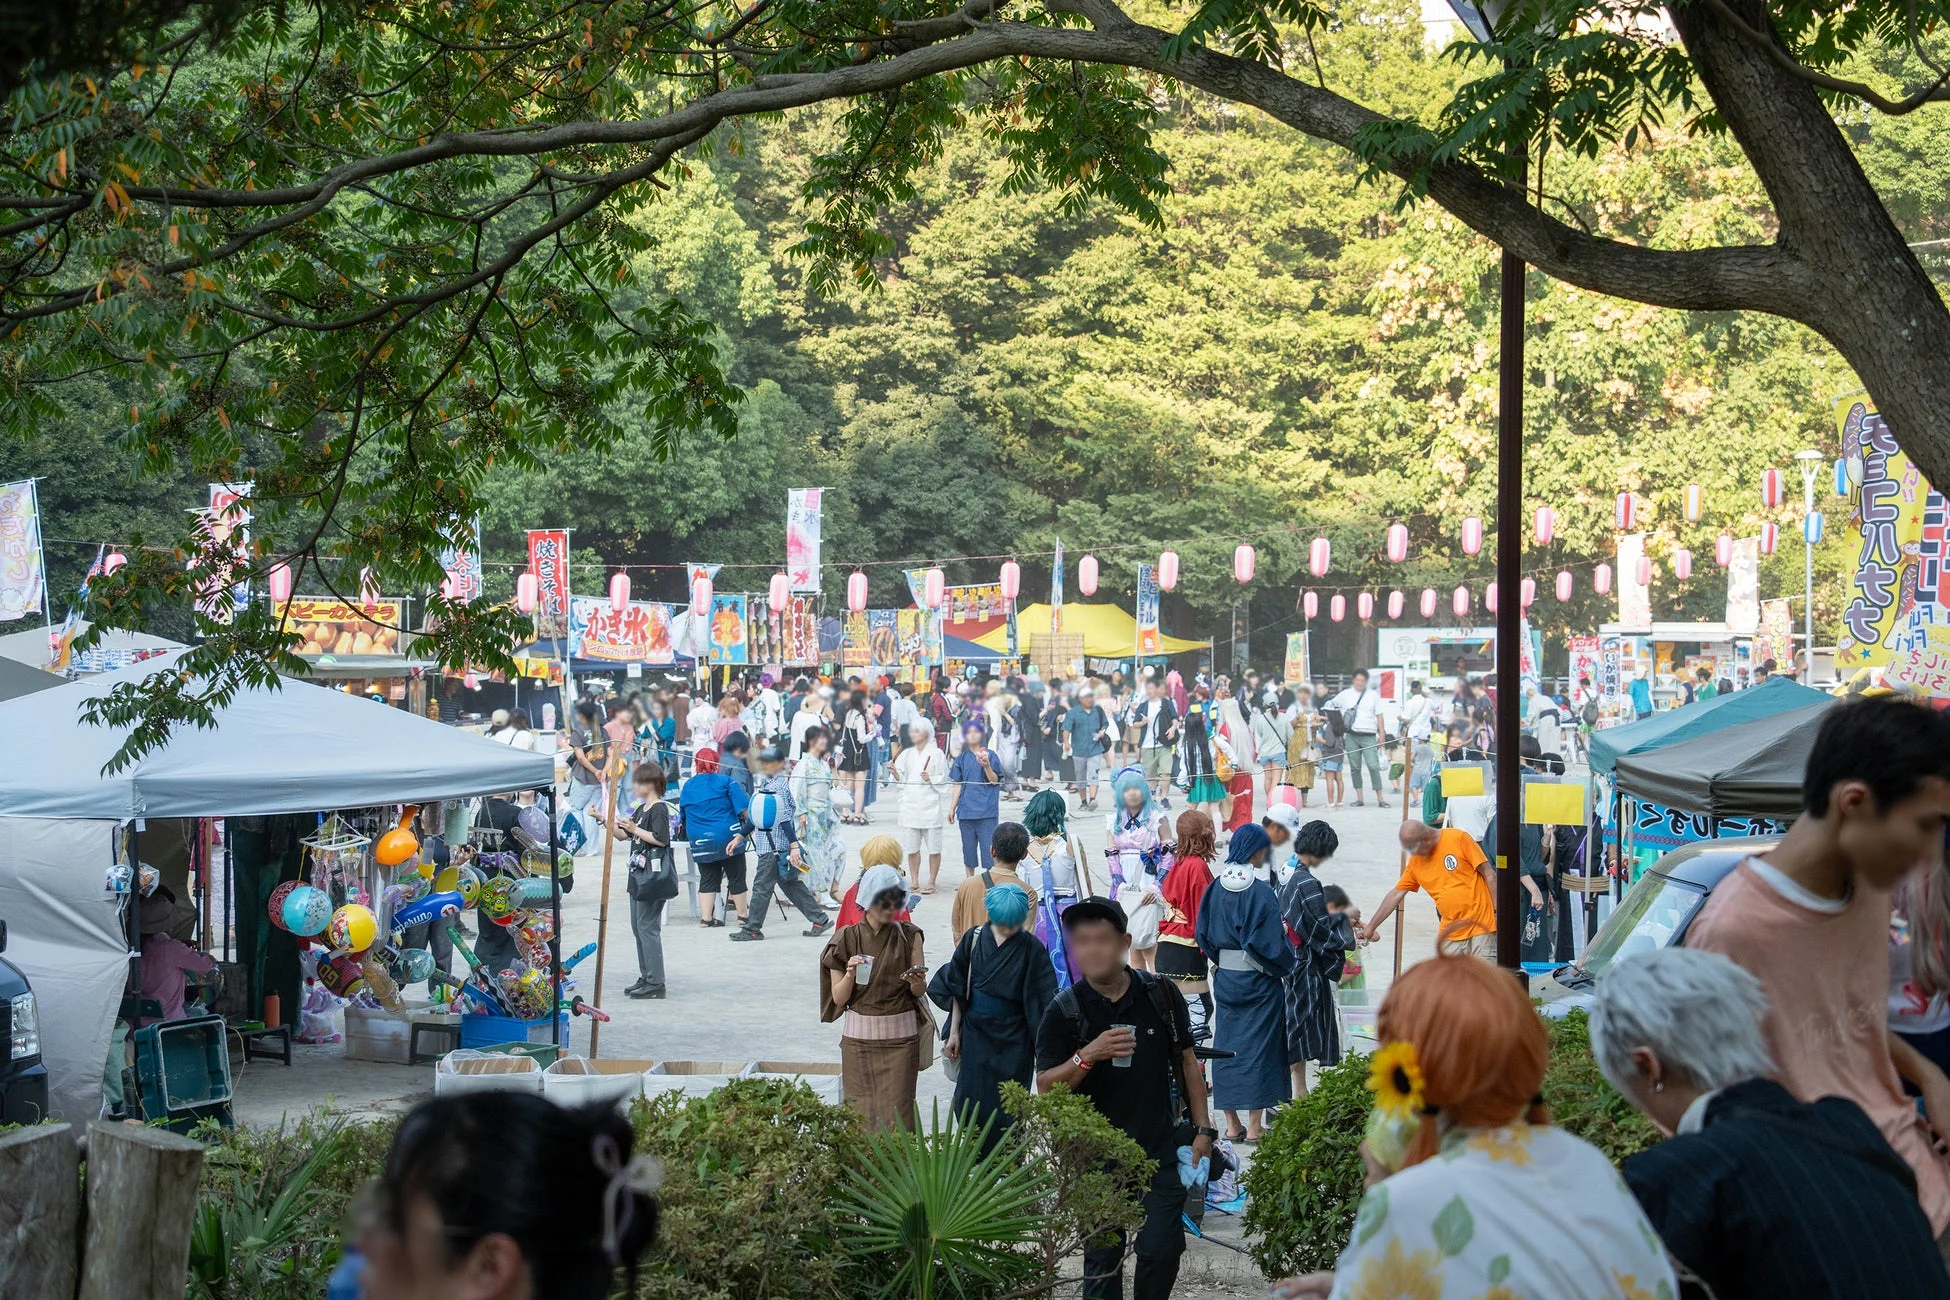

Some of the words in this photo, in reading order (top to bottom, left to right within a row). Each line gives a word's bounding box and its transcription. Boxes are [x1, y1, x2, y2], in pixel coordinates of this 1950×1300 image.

[536, 540, 562, 615] 焼きそば
[278, 603, 396, 621] ベビーカステラ
[585, 606, 650, 645] かき氷
